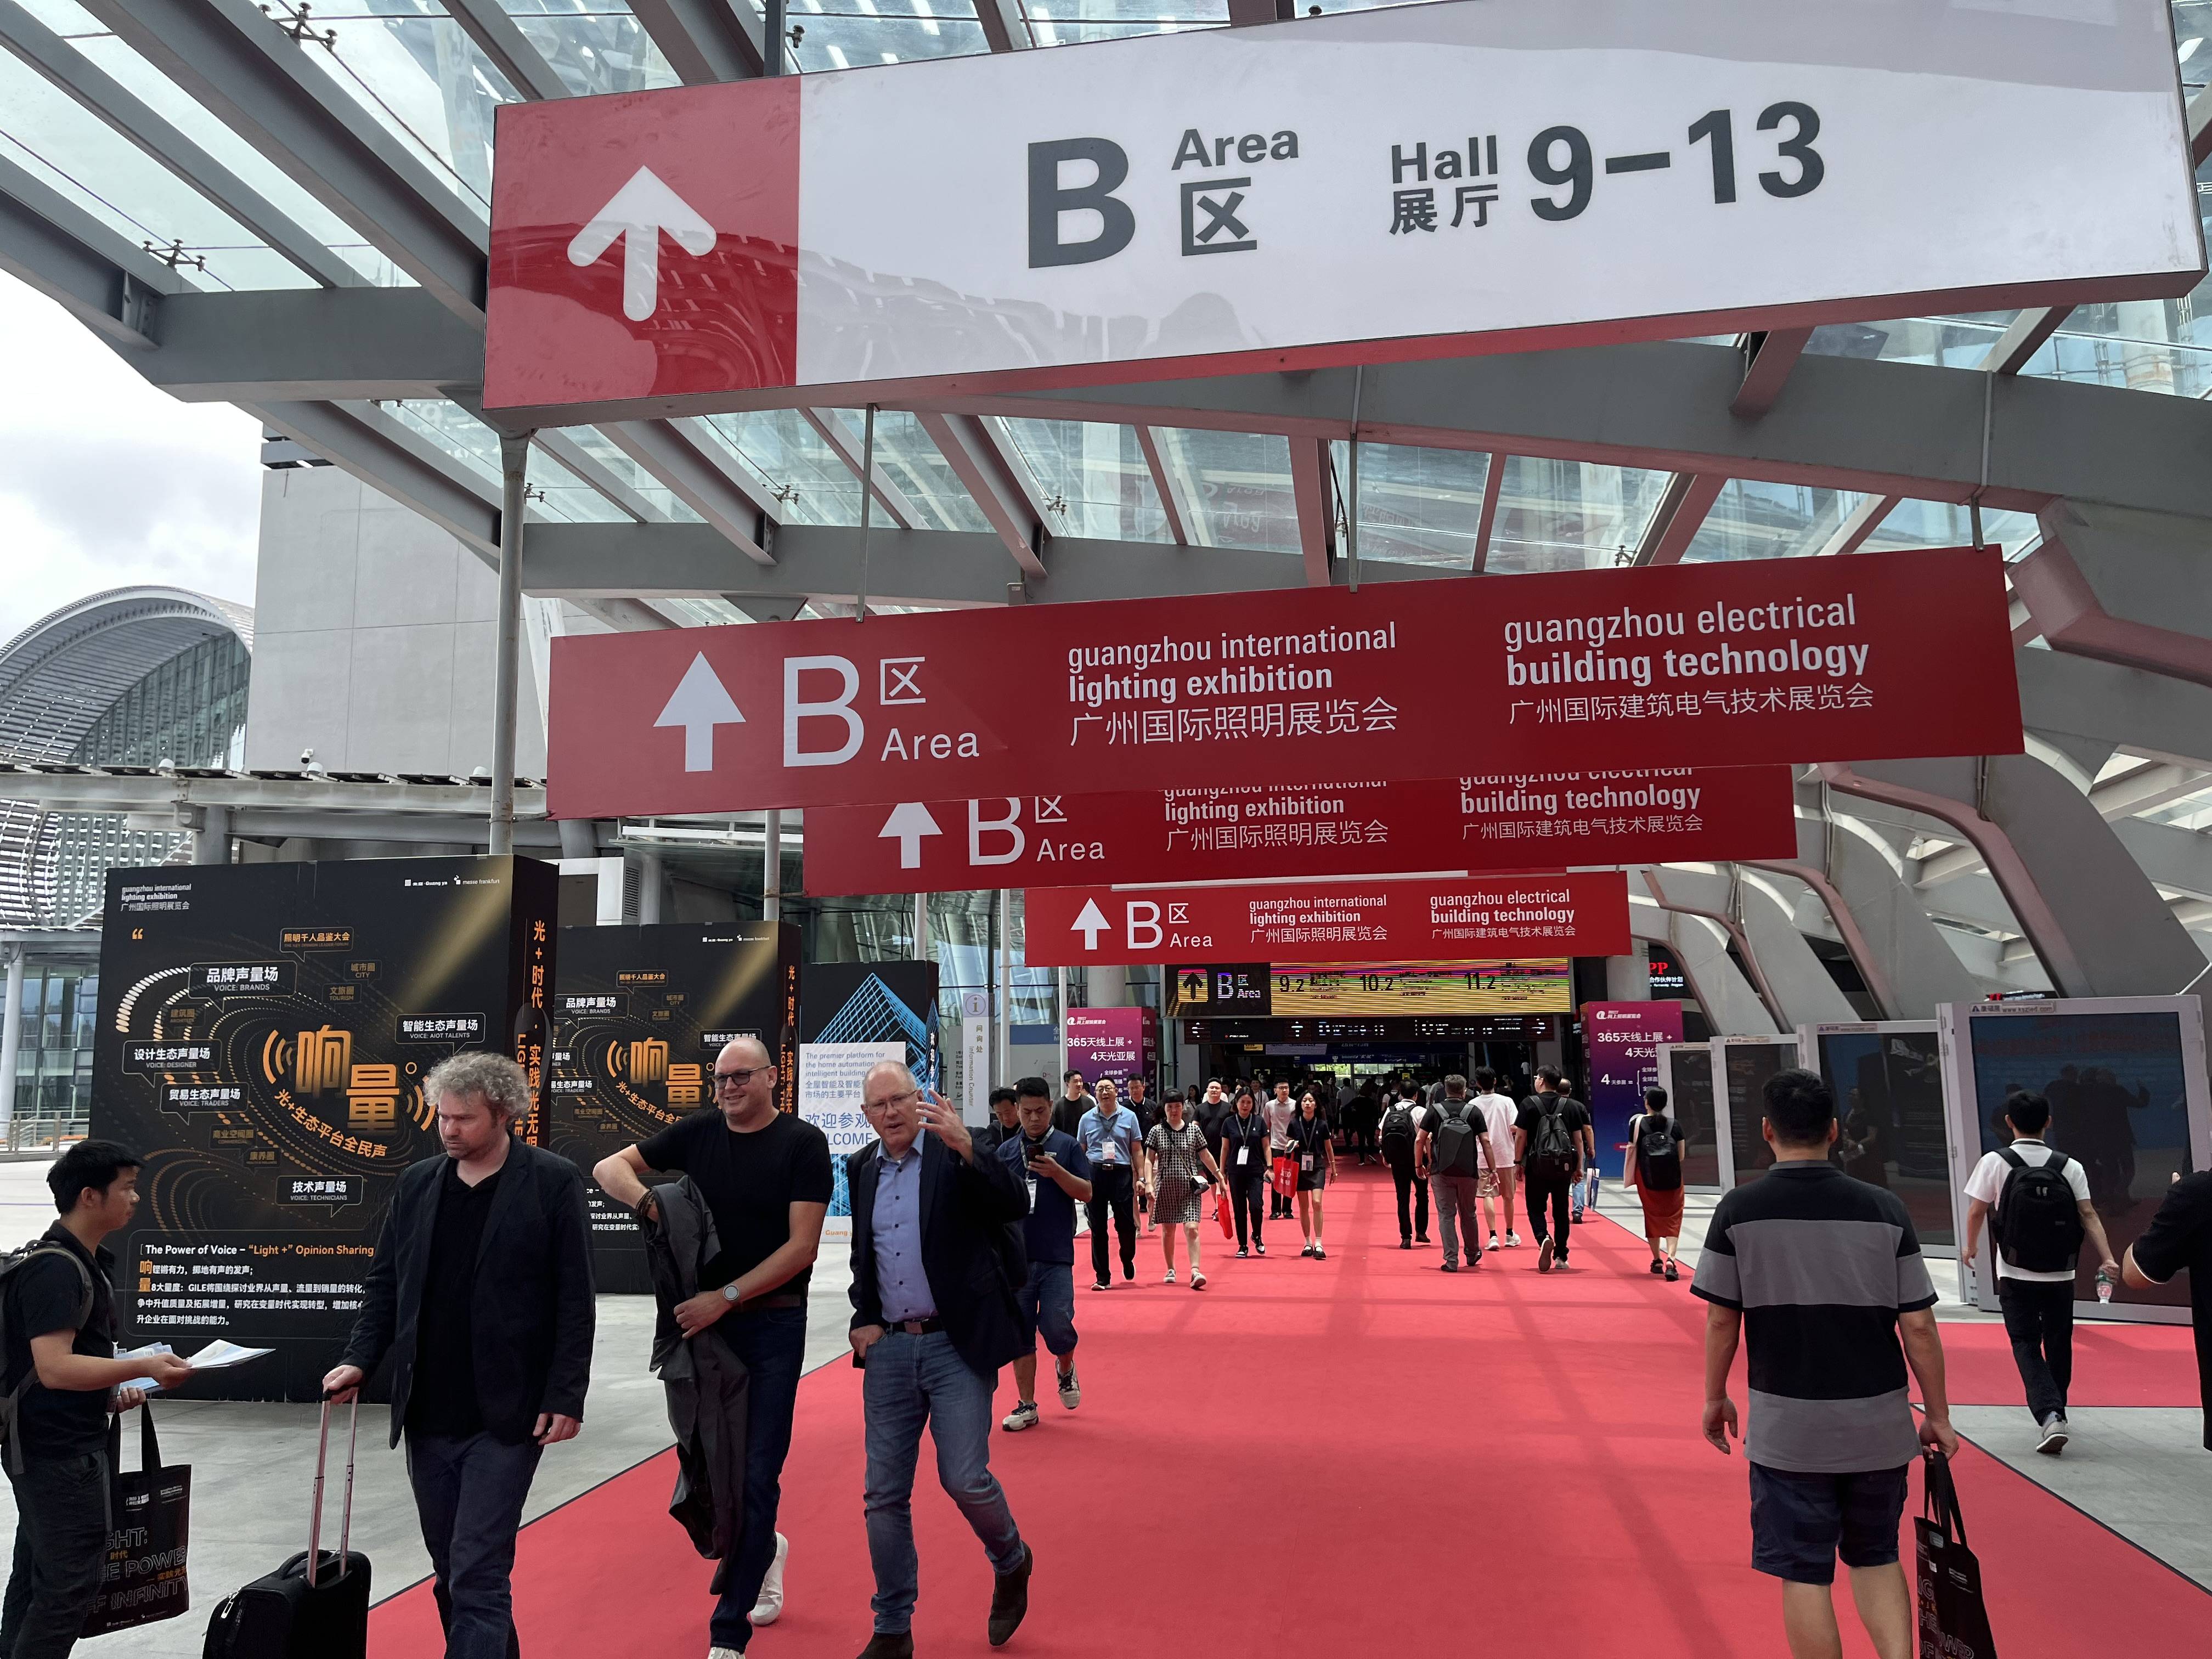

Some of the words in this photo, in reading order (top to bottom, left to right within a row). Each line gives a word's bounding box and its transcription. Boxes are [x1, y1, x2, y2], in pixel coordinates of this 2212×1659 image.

[1171, 126, 1299, 171] Area
[1392, 134, 1498, 184] Hall
[1029, 137, 1136, 269] B
[1390, 185, 1499, 235] 展厅
[1181, 177, 1257, 257] 区
[1504, 606, 1684, 652] guangzhou
[1697, 593, 1856, 633] electrical
[1068, 635, 1211, 674] guangzhou
[1221, 620, 1397, 659] international
[1507, 648, 1651, 687] building
[1663, 639, 1869, 679] technology
[881, 656, 926, 705] 区
[1069, 673, 1176, 707] lighting
[1186, 665, 1333, 697] exhibition
[783, 655, 865, 768] B
[1510, 682, 1874, 725] 广州国际建筑电气技术展览会
[1070, 696, 1398, 748] 广州国际照明展览会
[881, 729, 980, 763] Area
[1460, 789, 1558, 815] building
[1566, 783, 1701, 811] technology
[1035, 795, 1068, 824] 区
[1165, 802, 1239, 825] lighting
[1245, 796, 1344, 817] exhibition
[968, 795, 1025, 867] B
[1166, 819, 1389, 852] 广州国际照明展览会
[1463, 814, 1703, 840] 广州国际建筑电气技术展览会
[1037, 838, 1105, 862] Area
[121, 893, 145, 902] lighting
[146, 892, 178, 900] exhibition
[122, 884, 153, 894] guangzhou
[154, 883, 191, 891] international
[1249, 897, 1310, 912] guangzhou
[1313, 894, 1387, 909] international
[1430, 893, 1503, 910] guangzhou
[1507, 889, 1570, 905] electrical
[1169, 903, 1189, 923] 区
[1250, 912, 1296, 926] lighting
[1300, 911, 1361, 923] exhibition
[1431, 909, 1489, 925] building
[1493, 907, 1575, 924] technology
[1127, 901, 1163, 950] B
[1432, 925, 1576, 940] 广州国际建筑电气技术展览会
[284, 932, 351, 943] 照明千人品鉴大会
[1170, 934, 1213, 948] Area
[1250, 926, 1387, 944] 广州国际照明展览会
[206, 966, 278, 983] 品牌声量场
[1279, 975, 1305, 992] 9.2
[1361, 974, 1393, 991] 10.2
[1464, 972, 1496, 990] 11.2
[240, 983, 270, 991] BRANDS
[1217, 972, 1234, 998] B
[1237, 989, 1261, 998] Area
[566, 997, 617, 1008] 品牌声量场
[403, 1019, 478, 1032] 智能生态声量场
[1067, 1037, 1125, 1047] 365天线上展
[1597, 1032, 1663, 1043] 365天线上展
[134, 1047, 211, 1060] 设计生态声量场
[1090, 1051, 1136, 1062] 4天光亚展
[1625, 1047, 1658, 1058] 4天光
[805, 1080, 863, 1089] 全屋智能及智能
[1601, 1074, 1610, 1085] 4
[169, 1088, 241, 1101] 贸易生态声量场
[805, 1090, 861, 1099] 市场的主要平台
[805, 1112, 871, 1129] 欢迎参观
[827, 1133, 873, 1145] LCOME
[292, 1181, 347, 1193] 技术声量场
[145, 1245, 163, 1255] The
[165, 1245, 195, 1255] Power
[198, 1245, 208, 1255] of
[211, 1245, 238, 1255] Voice
[295, 1245, 335, 1256] Opinion
[336, 1245, 374, 1257] Sharing
